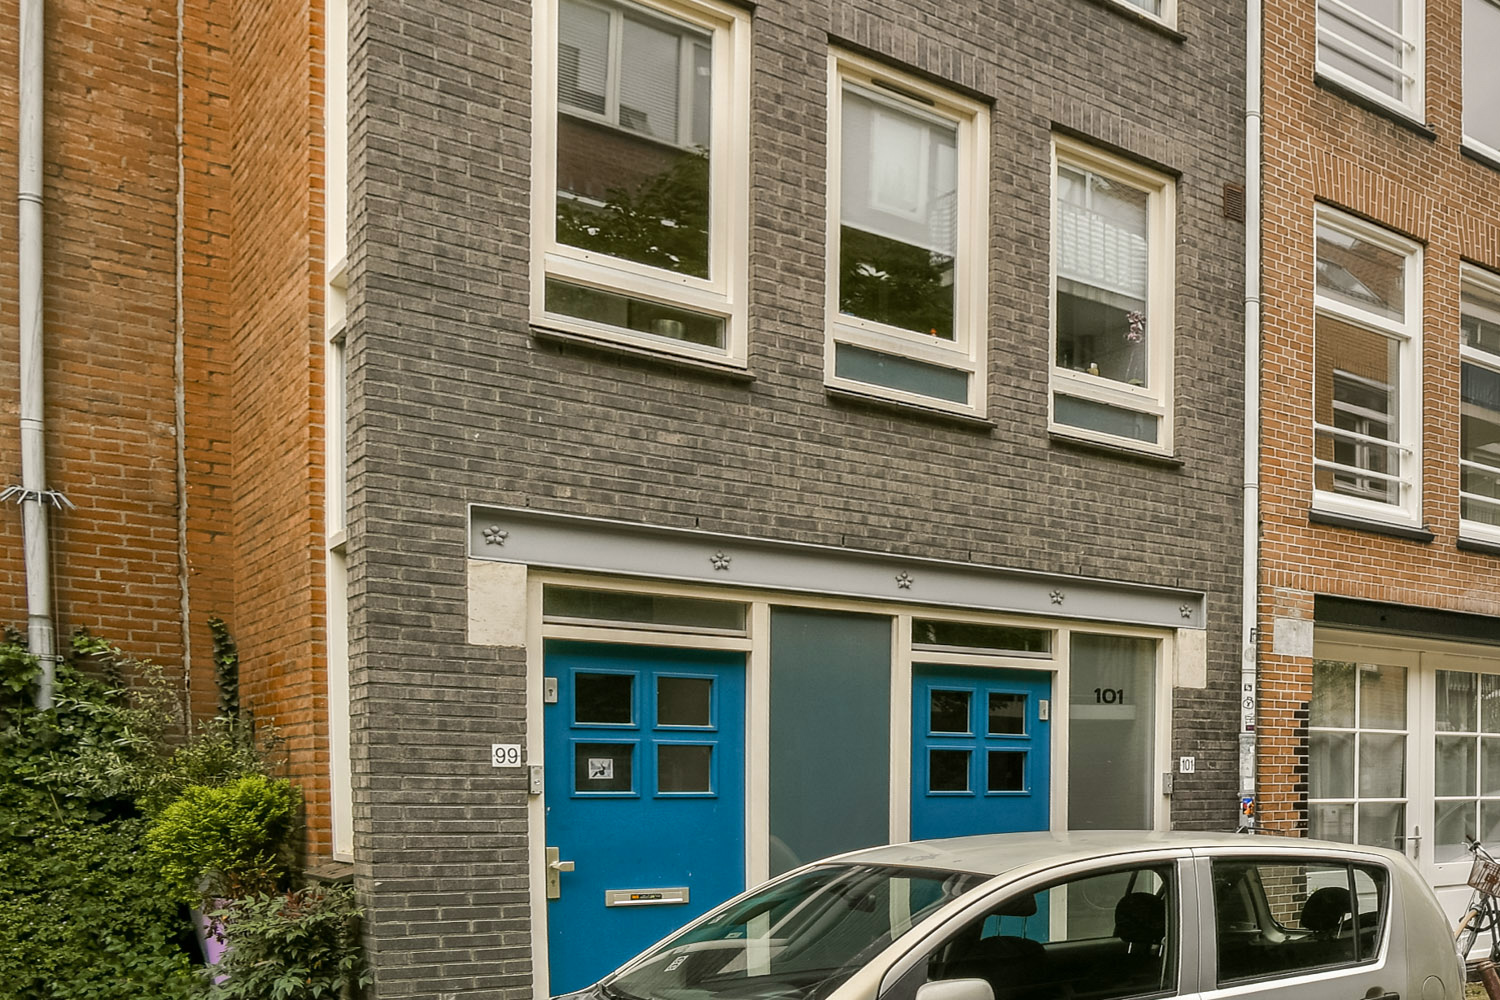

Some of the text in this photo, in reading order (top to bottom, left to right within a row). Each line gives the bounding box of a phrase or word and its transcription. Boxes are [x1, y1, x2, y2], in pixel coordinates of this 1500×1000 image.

[1094, 688, 1124, 705] 101
[495, 747, 518, 764] 99
[1182, 759, 1194, 771] 101
